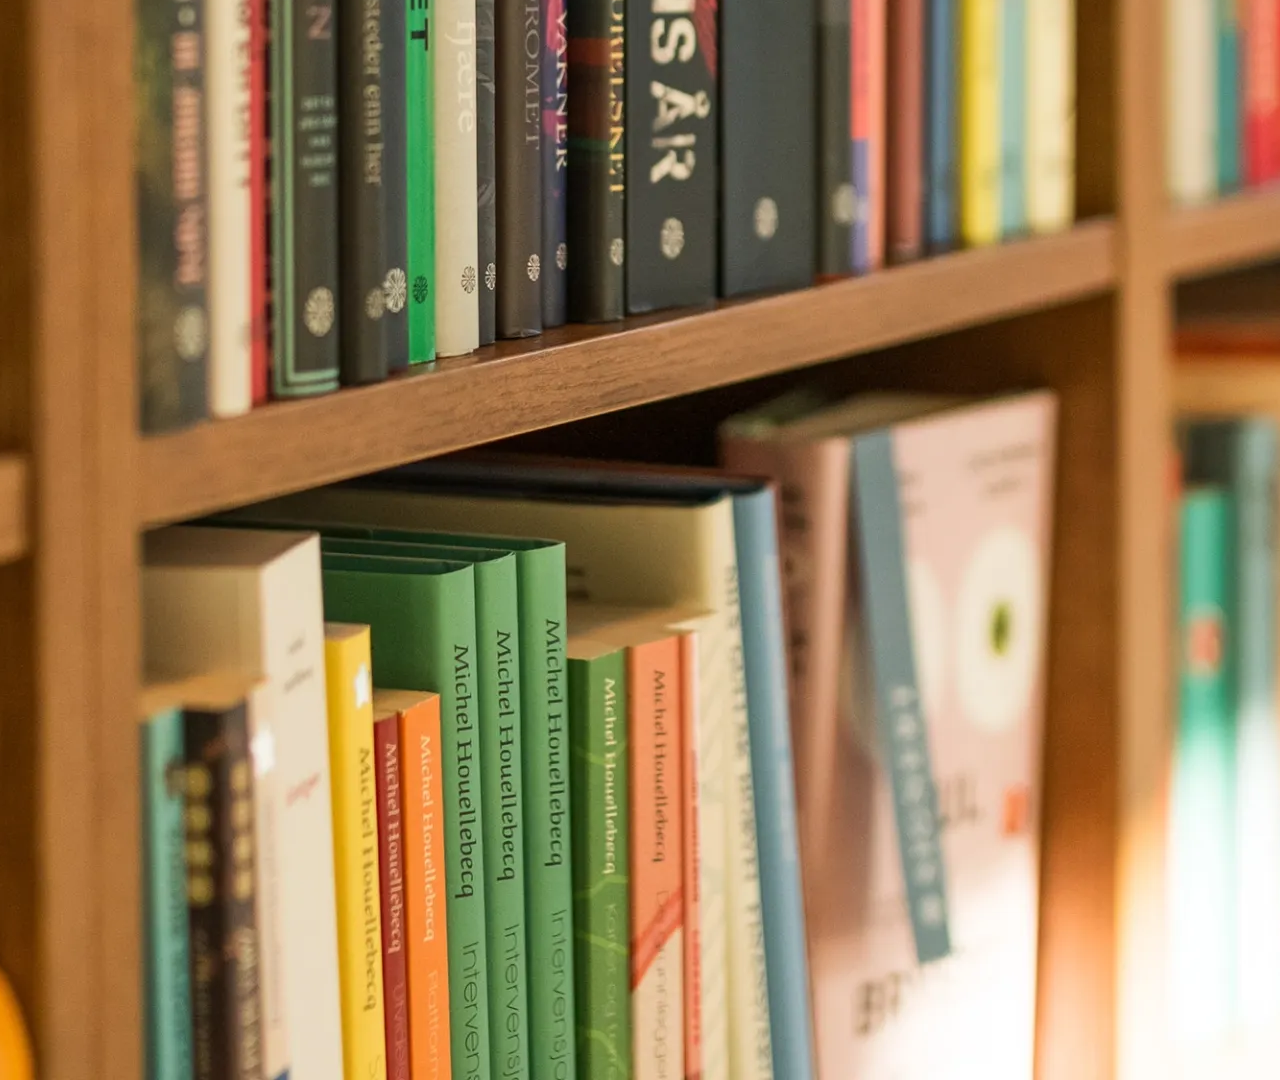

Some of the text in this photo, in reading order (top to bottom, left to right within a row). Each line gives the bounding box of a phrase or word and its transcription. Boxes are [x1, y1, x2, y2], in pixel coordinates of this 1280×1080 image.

[364, 84, 381, 136] enn
[445, 19, 474, 133] fjære
[649, 80, 710, 185] ÅR
[453, 644, 473, 733] Michel
[602, 677, 616, 746] Michel
[654, 670, 668, 737] Michel
[359, 747, 375, 838] Michel
[420, 735, 433, 807] Michel
[455, 739, 477, 899] Houellebecq
[602, 752, 616, 875] Houellebecq
[653, 747, 669, 865] Houellebecq
[422, 812, 437, 942] Houellebecq
[496, 629, 524, 1080] Michel Houellebecq Intervensj
[544, 619, 571, 1080] Michel Houellebecq Intervensjo
[363, 846, 379, 1011] Houellebecq
[385, 742, 408, 1080] Michel Houellebecq Utvidels
